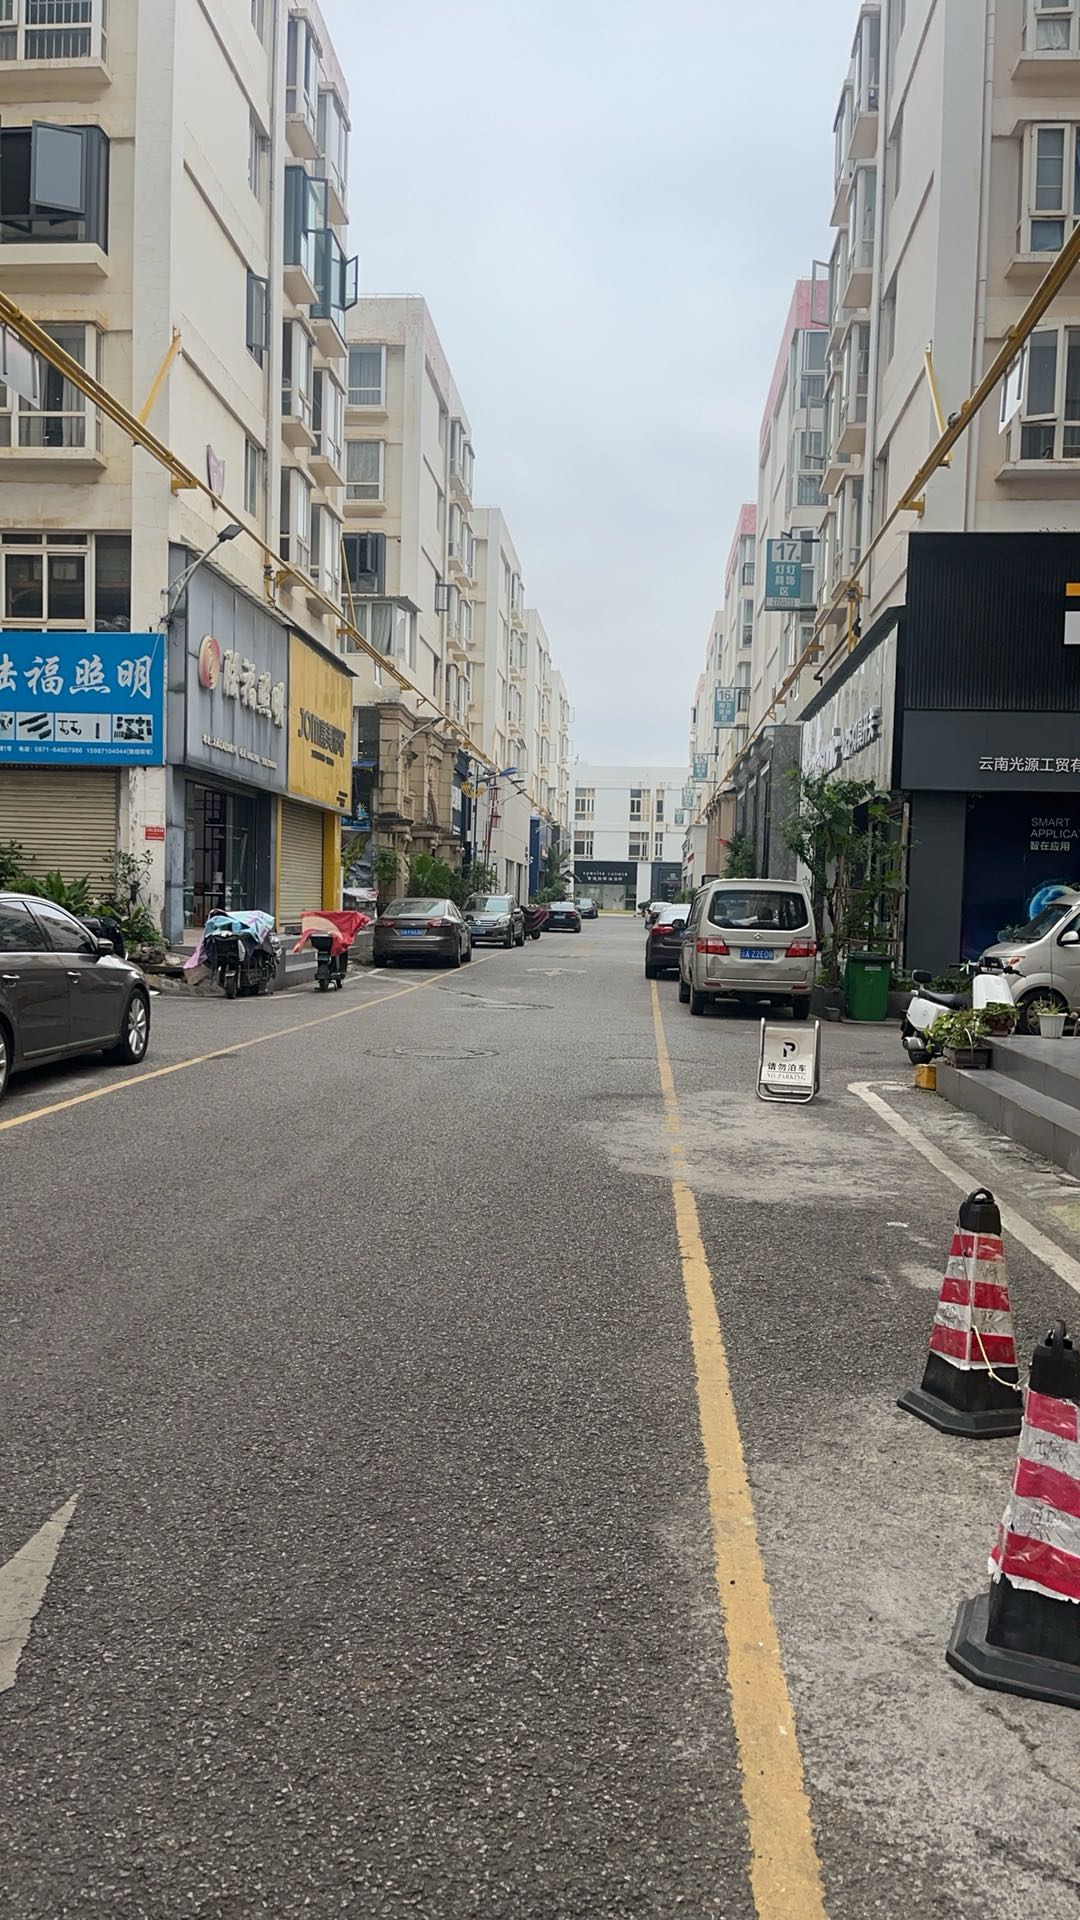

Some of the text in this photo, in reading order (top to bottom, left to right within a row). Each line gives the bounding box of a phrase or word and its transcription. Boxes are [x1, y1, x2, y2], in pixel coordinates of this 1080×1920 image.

[979, 756, 1080, 773] 云南光源工贸有
[1031, 817, 1071, 827] SMART
[1030, 828, 1080, 839] APPLICA
[767, 1061, 807, 1072] 请勿泊车
